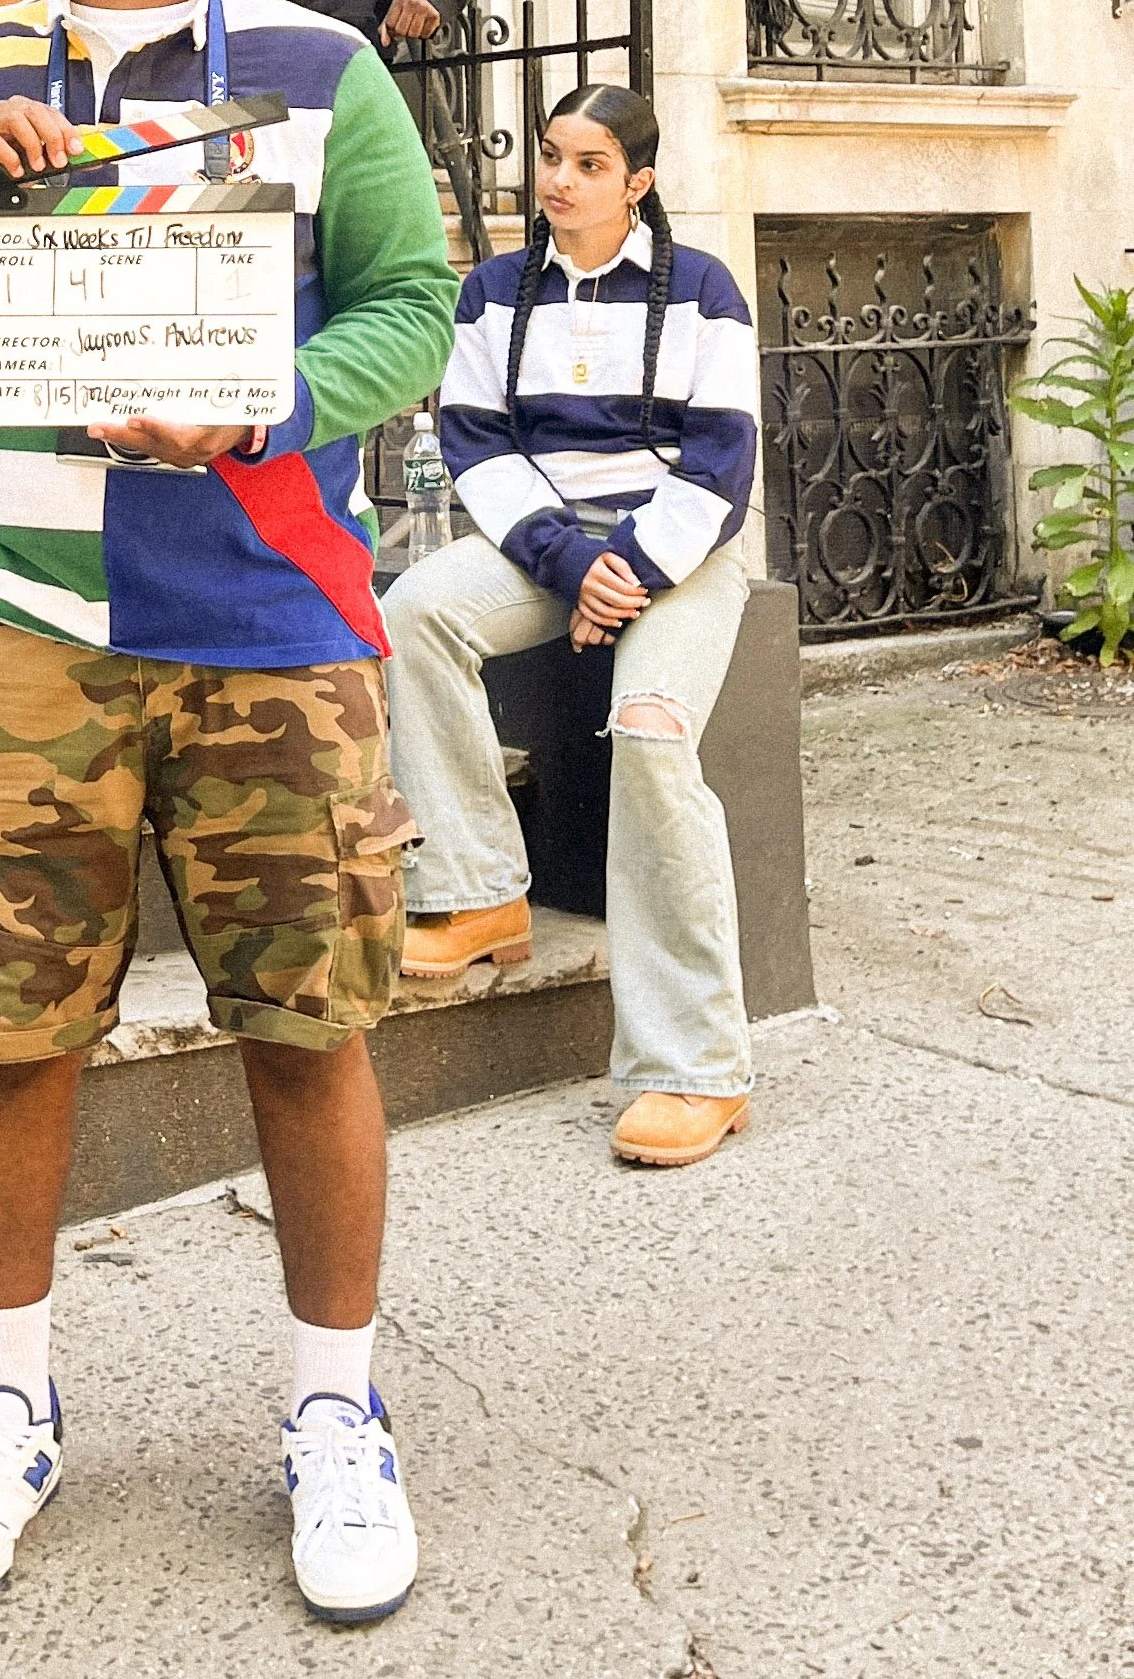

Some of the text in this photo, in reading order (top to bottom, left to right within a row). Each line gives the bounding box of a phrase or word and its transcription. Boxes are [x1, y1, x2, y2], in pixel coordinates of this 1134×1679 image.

[99, 254, 144, 266] SCENE
[220, 253, 256, 265] TAKE
[111, 387, 277, 401] Day Night Int Ext Mos
[111, 404, 148, 415] Filter
[244, 404, 277, 418] Sync
